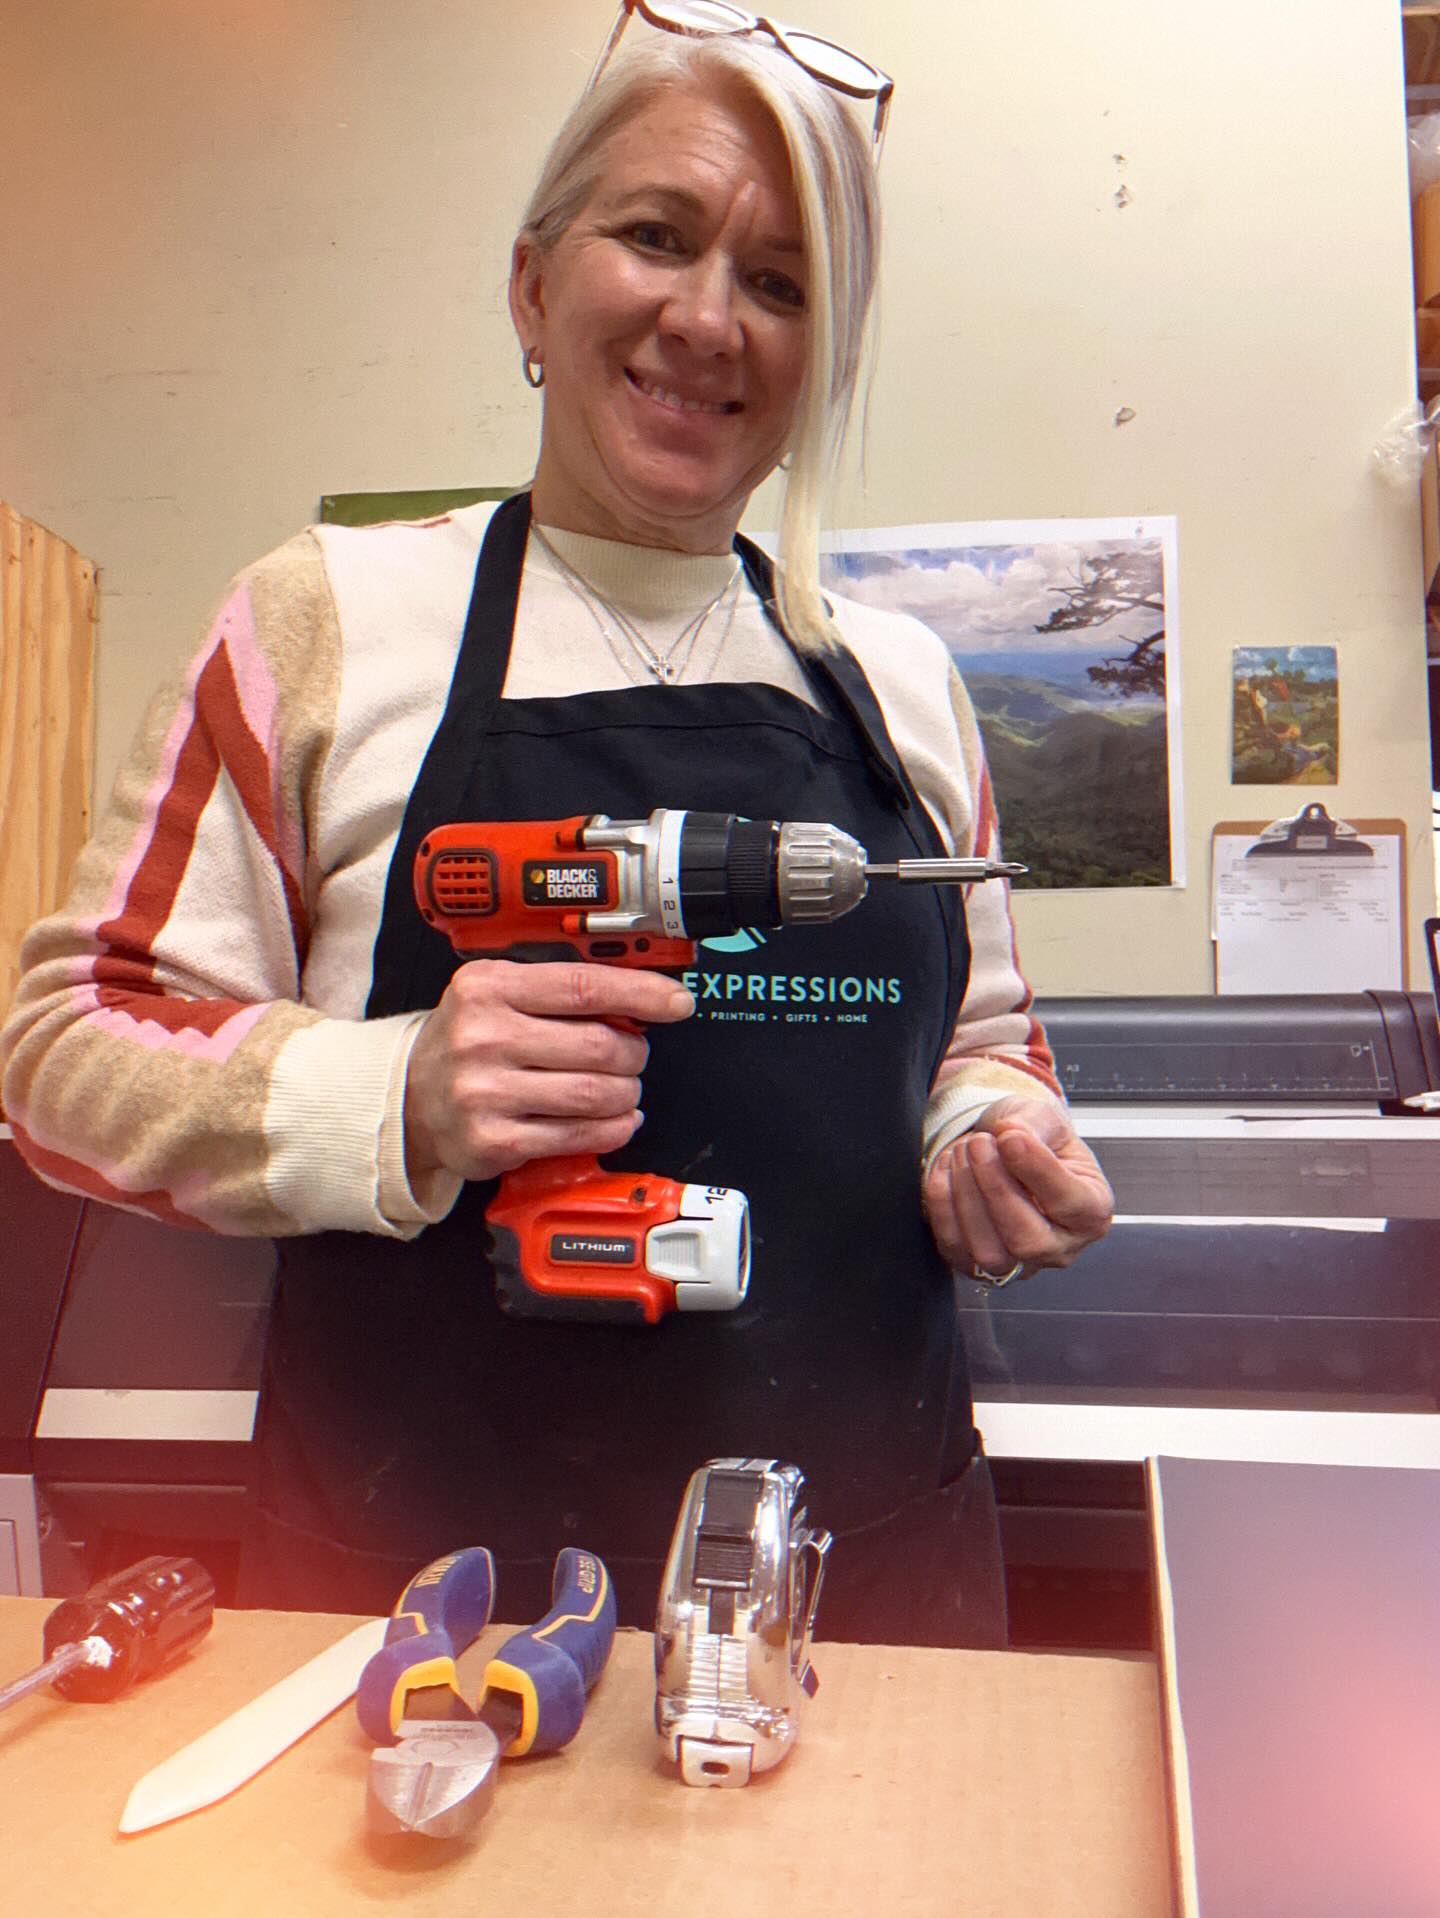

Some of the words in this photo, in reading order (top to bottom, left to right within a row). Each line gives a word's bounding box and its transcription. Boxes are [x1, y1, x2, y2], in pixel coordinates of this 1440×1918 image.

[547, 884, 598, 898] DECKER
[663, 900, 676, 911] 2
[666, 921, 679, 929] 3
[682, 972, 901, 1003] EXPRESSIONS
[710, 1011, 766, 1022] PRINTING
[785, 1013, 818, 1023] GIFTS
[837, 1014, 869, 1023] HOME
[562, 1241, 627, 1252] LITHIUM
